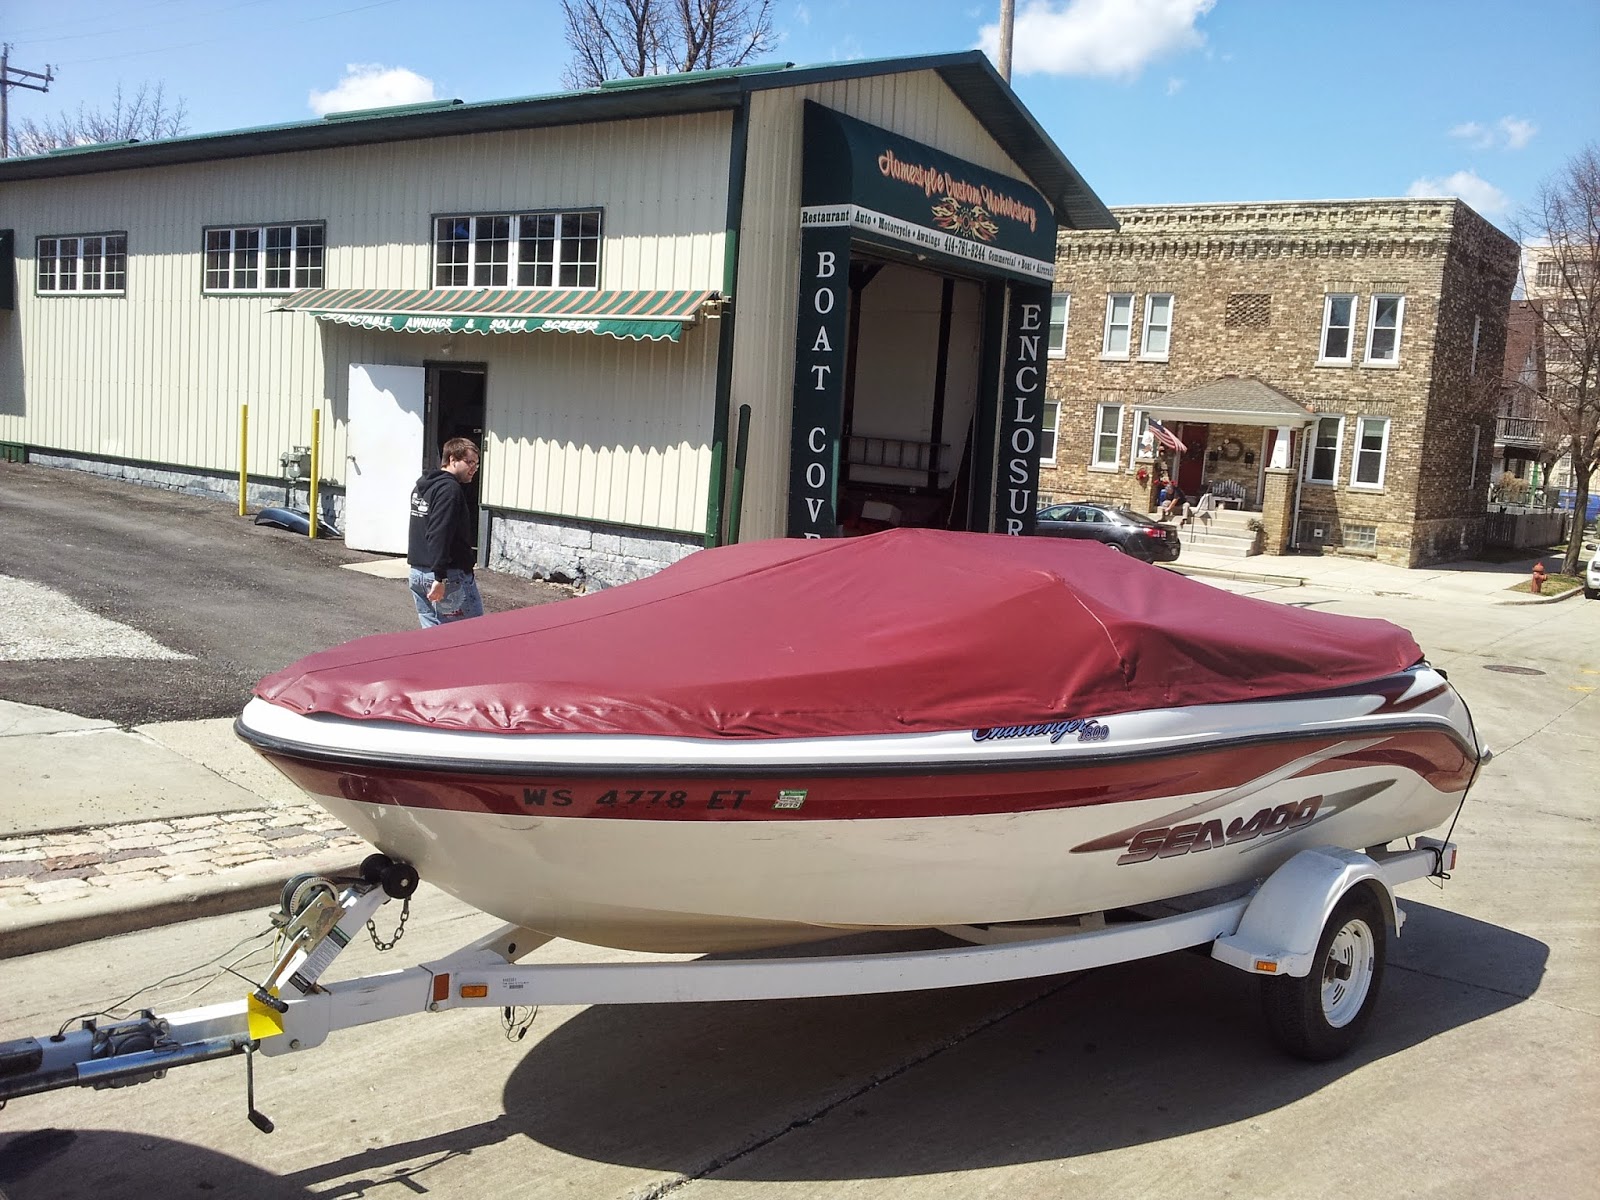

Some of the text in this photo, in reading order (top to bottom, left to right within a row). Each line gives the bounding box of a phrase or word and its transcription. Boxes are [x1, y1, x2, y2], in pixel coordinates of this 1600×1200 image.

[878, 150, 945, 198] Homestyle
[945, 172, 983, 206] Custom
[802, 210, 850, 224] Restaurant
[855, 210, 872, 226] Auto
[878, 217, 911, 238] Motorcycle
[916, 229, 941, 248] Awnings
[988, 250, 1017, 267] Commercial
[405, 316, 453, 328] AWNINGS
[465, 318, 474, 329] &
[811, 252, 836, 390] BOAT
[523, 788, 751, 810] WS 4778 ET
